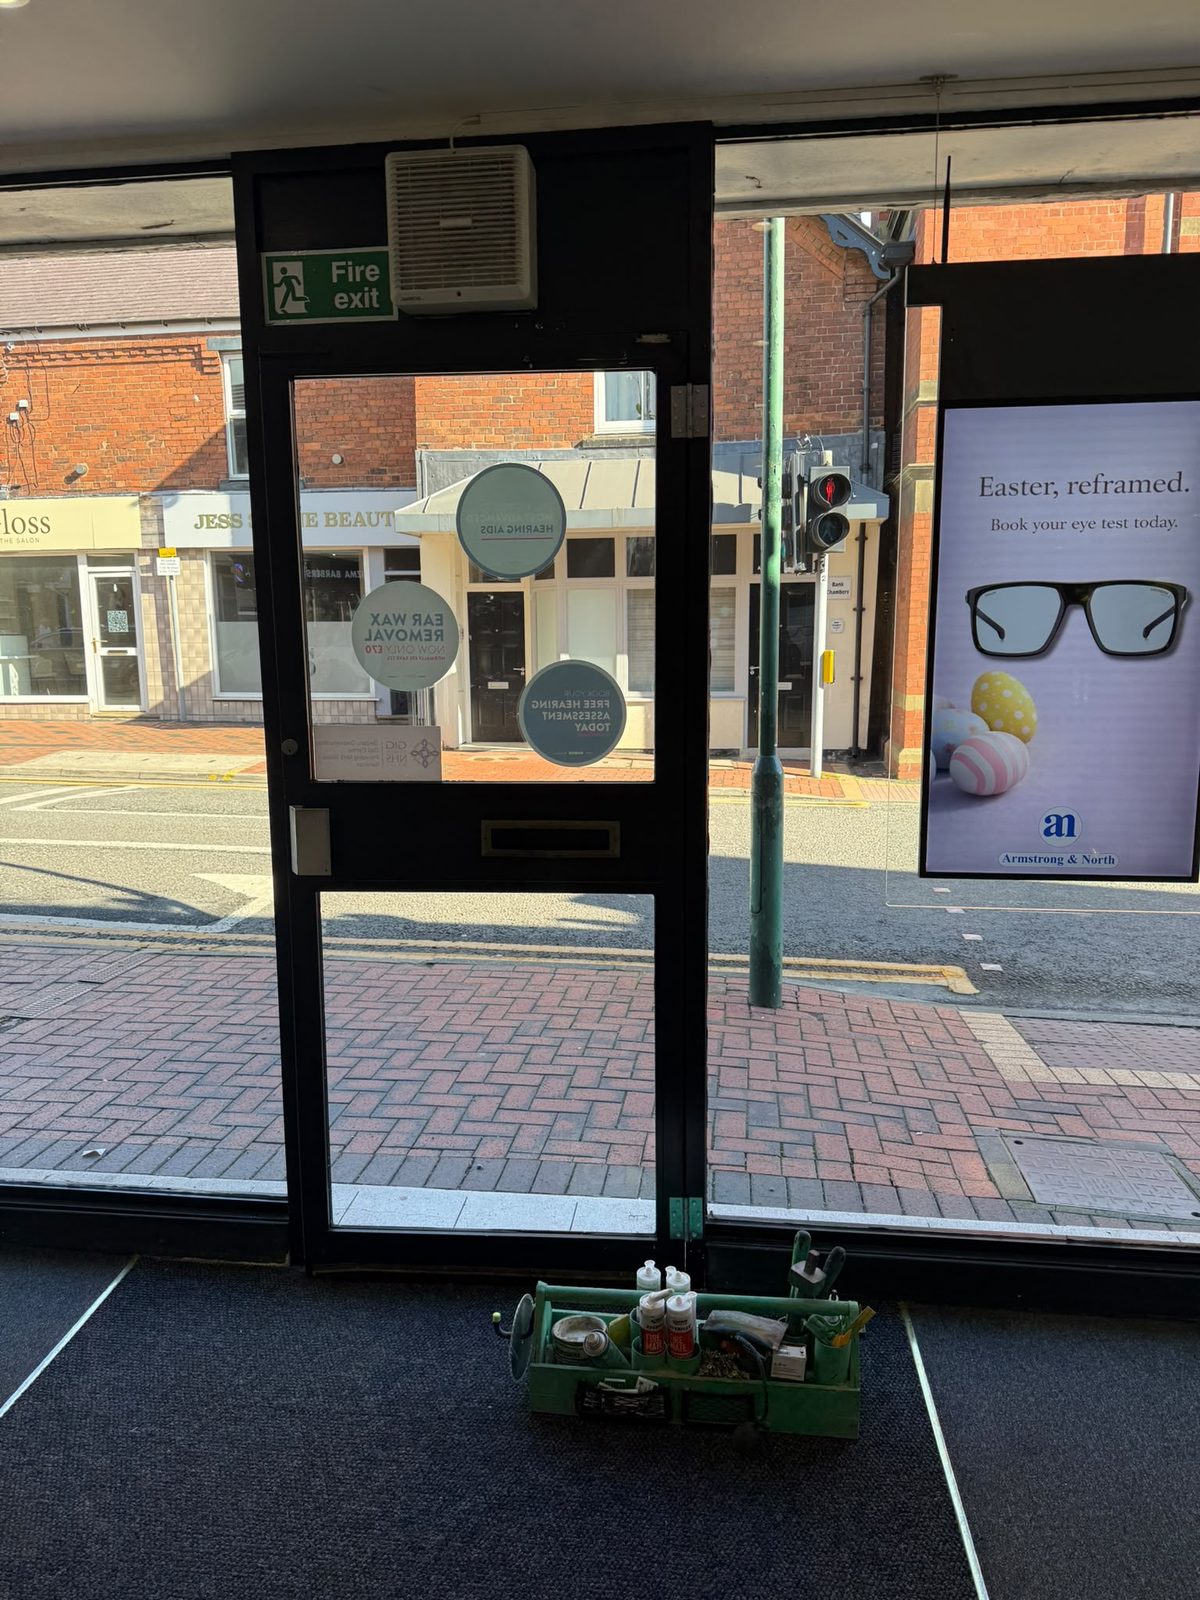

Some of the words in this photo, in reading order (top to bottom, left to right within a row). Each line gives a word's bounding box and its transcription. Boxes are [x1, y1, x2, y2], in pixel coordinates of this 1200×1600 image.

[331, 260, 380, 283] Fire
[334, 287, 380, 310] exit
[978, 474, 1058, 499] Easter,
[1067, 471, 1190, 494] reframed.
[0, 508, 51, 534] loss
[194, 514, 242, 530] JESS
[324, 511, 396, 528] BEAUT
[990, 516, 1028, 532] Book
[1032, 520, 1066, 535] your
[1071, 519, 1097, 534] eye
[1102, 516, 1128, 530] test
[1133, 516, 1178, 533] today.
[1002, 854, 1064, 866] Armstrong
[1067, 854, 1078, 865] &
[1082, 854, 1116, 866] North
